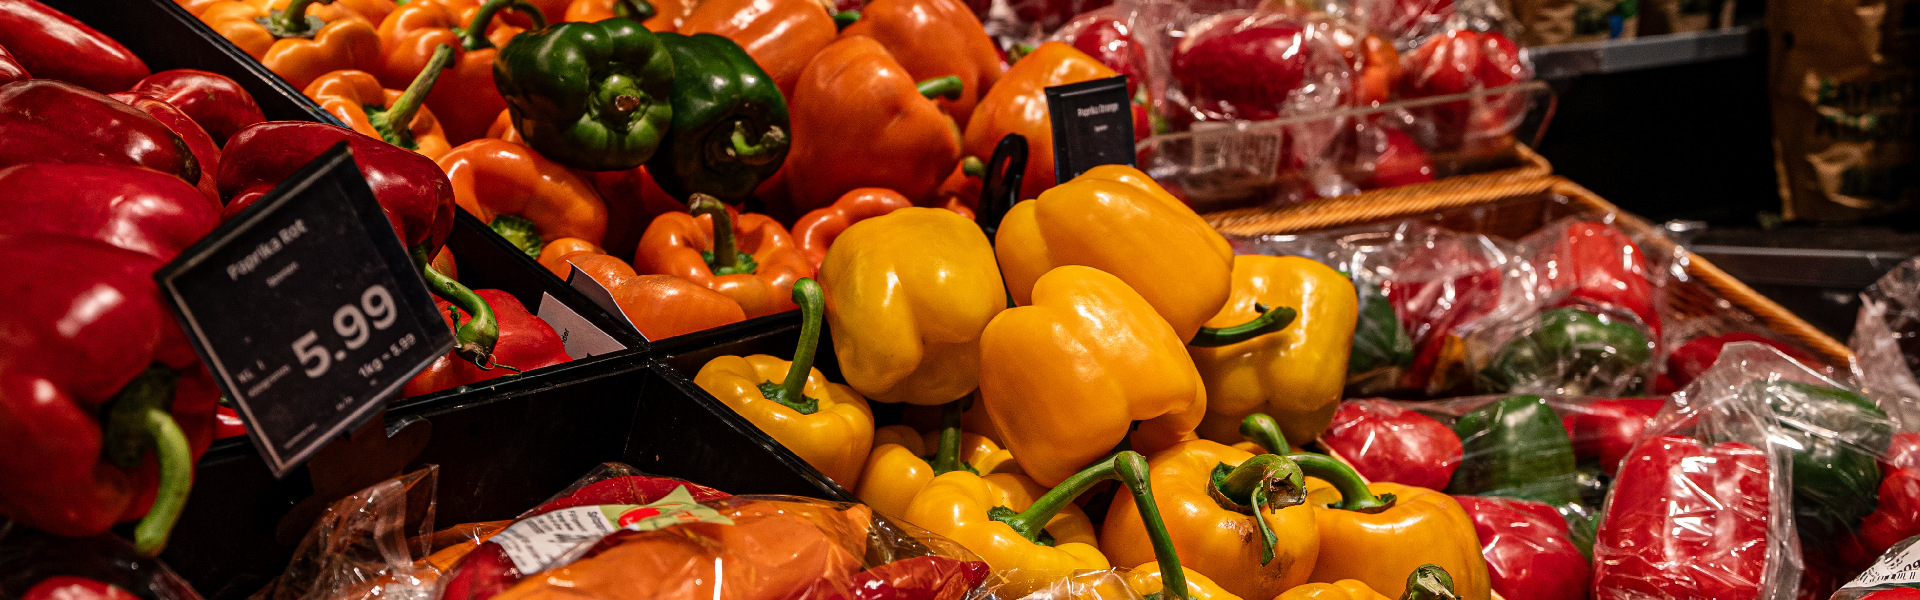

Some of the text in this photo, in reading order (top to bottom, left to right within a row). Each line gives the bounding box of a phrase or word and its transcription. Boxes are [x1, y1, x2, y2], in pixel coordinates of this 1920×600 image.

[227, 236, 281, 280] Paprika
[280, 219, 307, 244] Rot
[291, 284, 398, 379] 5.99
[358, 358, 384, 377] 1kg
